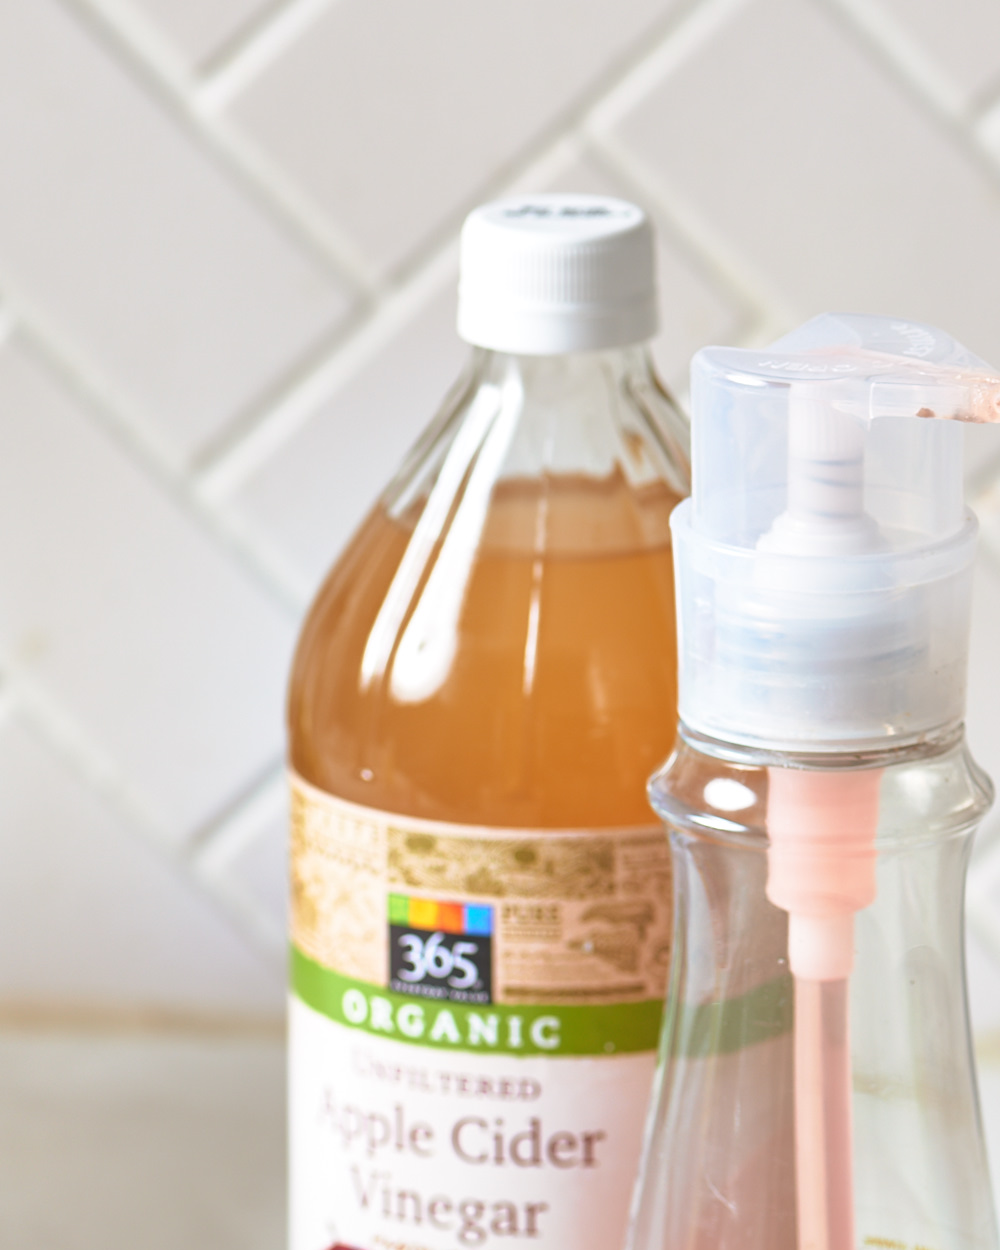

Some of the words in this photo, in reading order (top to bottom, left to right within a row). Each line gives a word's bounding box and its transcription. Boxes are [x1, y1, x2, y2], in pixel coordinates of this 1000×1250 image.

[397, 931, 479, 990] 365
[342, 988, 562, 1049] ORGANIC
[318, 1083, 435, 1159] Apple
[451, 1115, 607, 1170] Cider
[350, 1163, 550, 1249] Vinegar
